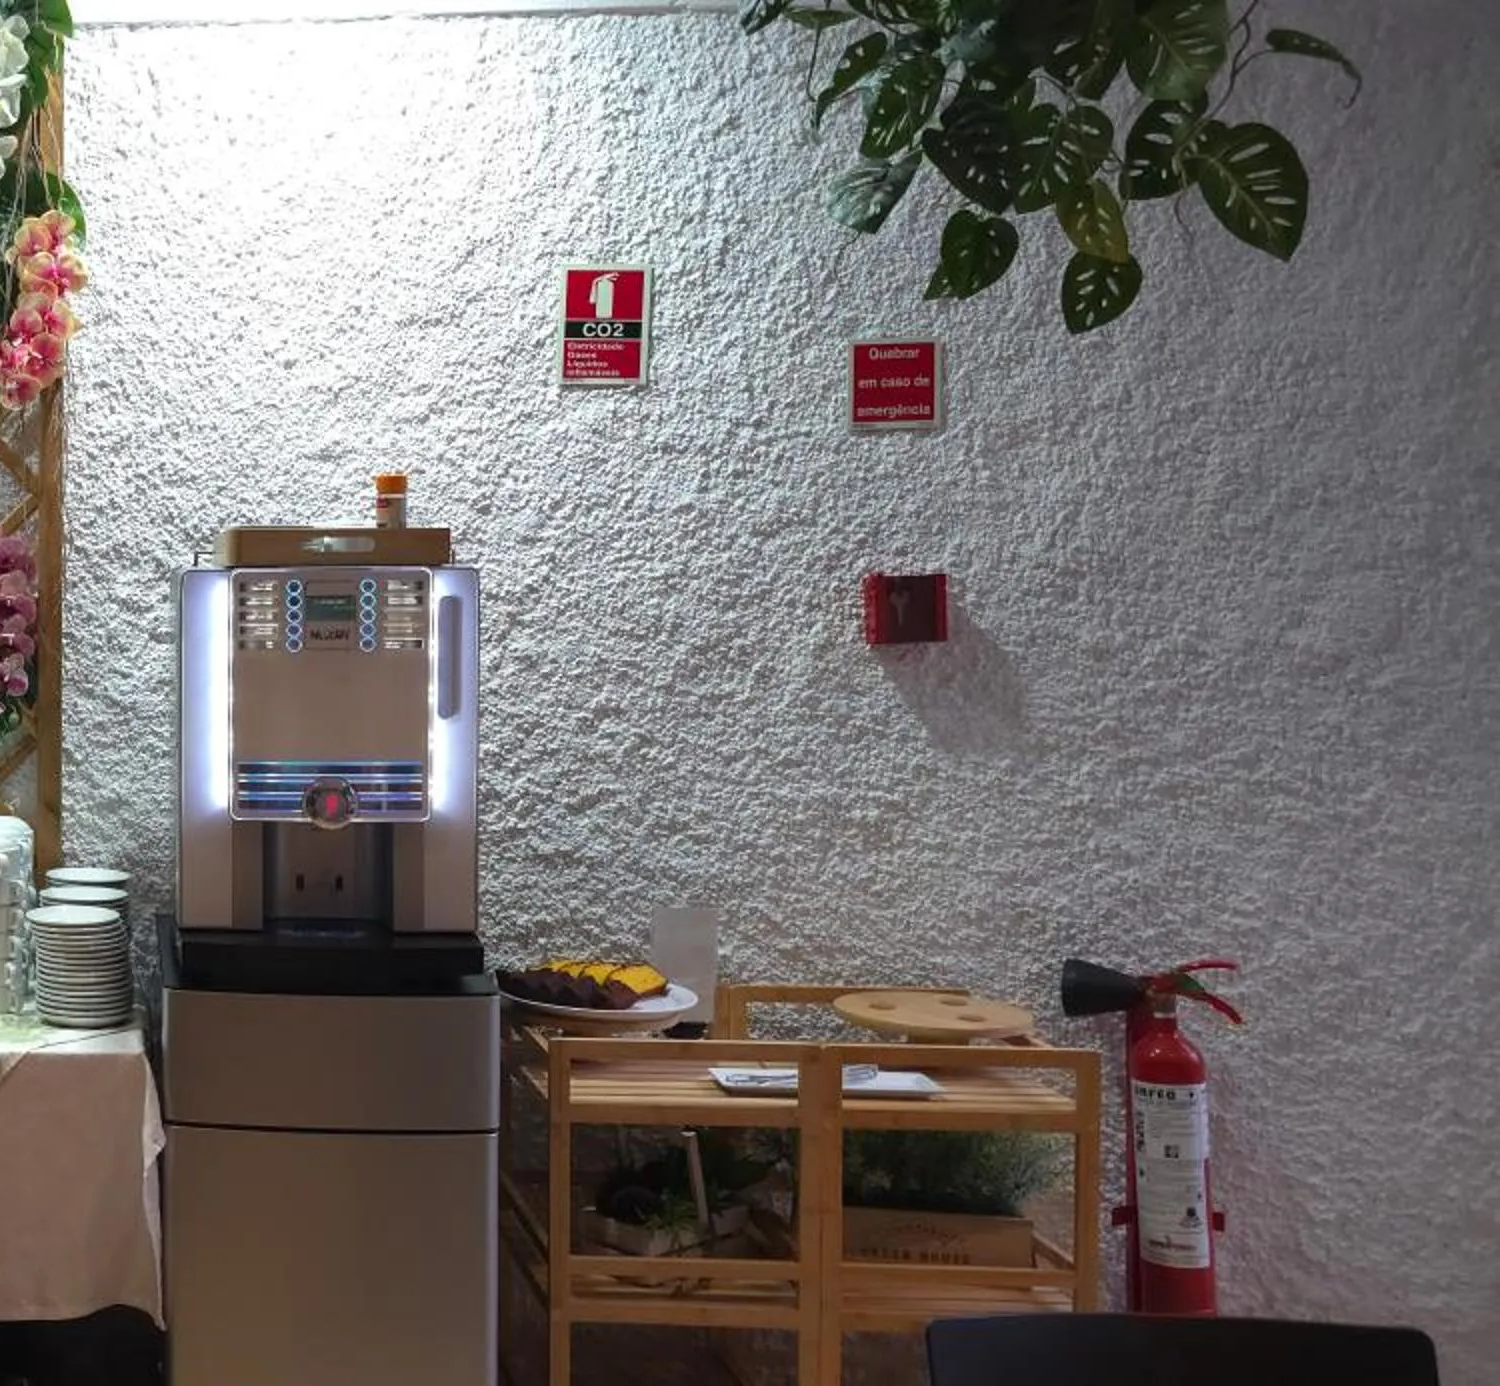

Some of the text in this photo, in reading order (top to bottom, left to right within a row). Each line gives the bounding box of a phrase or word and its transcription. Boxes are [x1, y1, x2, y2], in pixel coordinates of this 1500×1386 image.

[582, 322, 625, 337] CO2
[868, 346, 920, 360] Quebrar
[857, 374, 930, 389] em caso de
